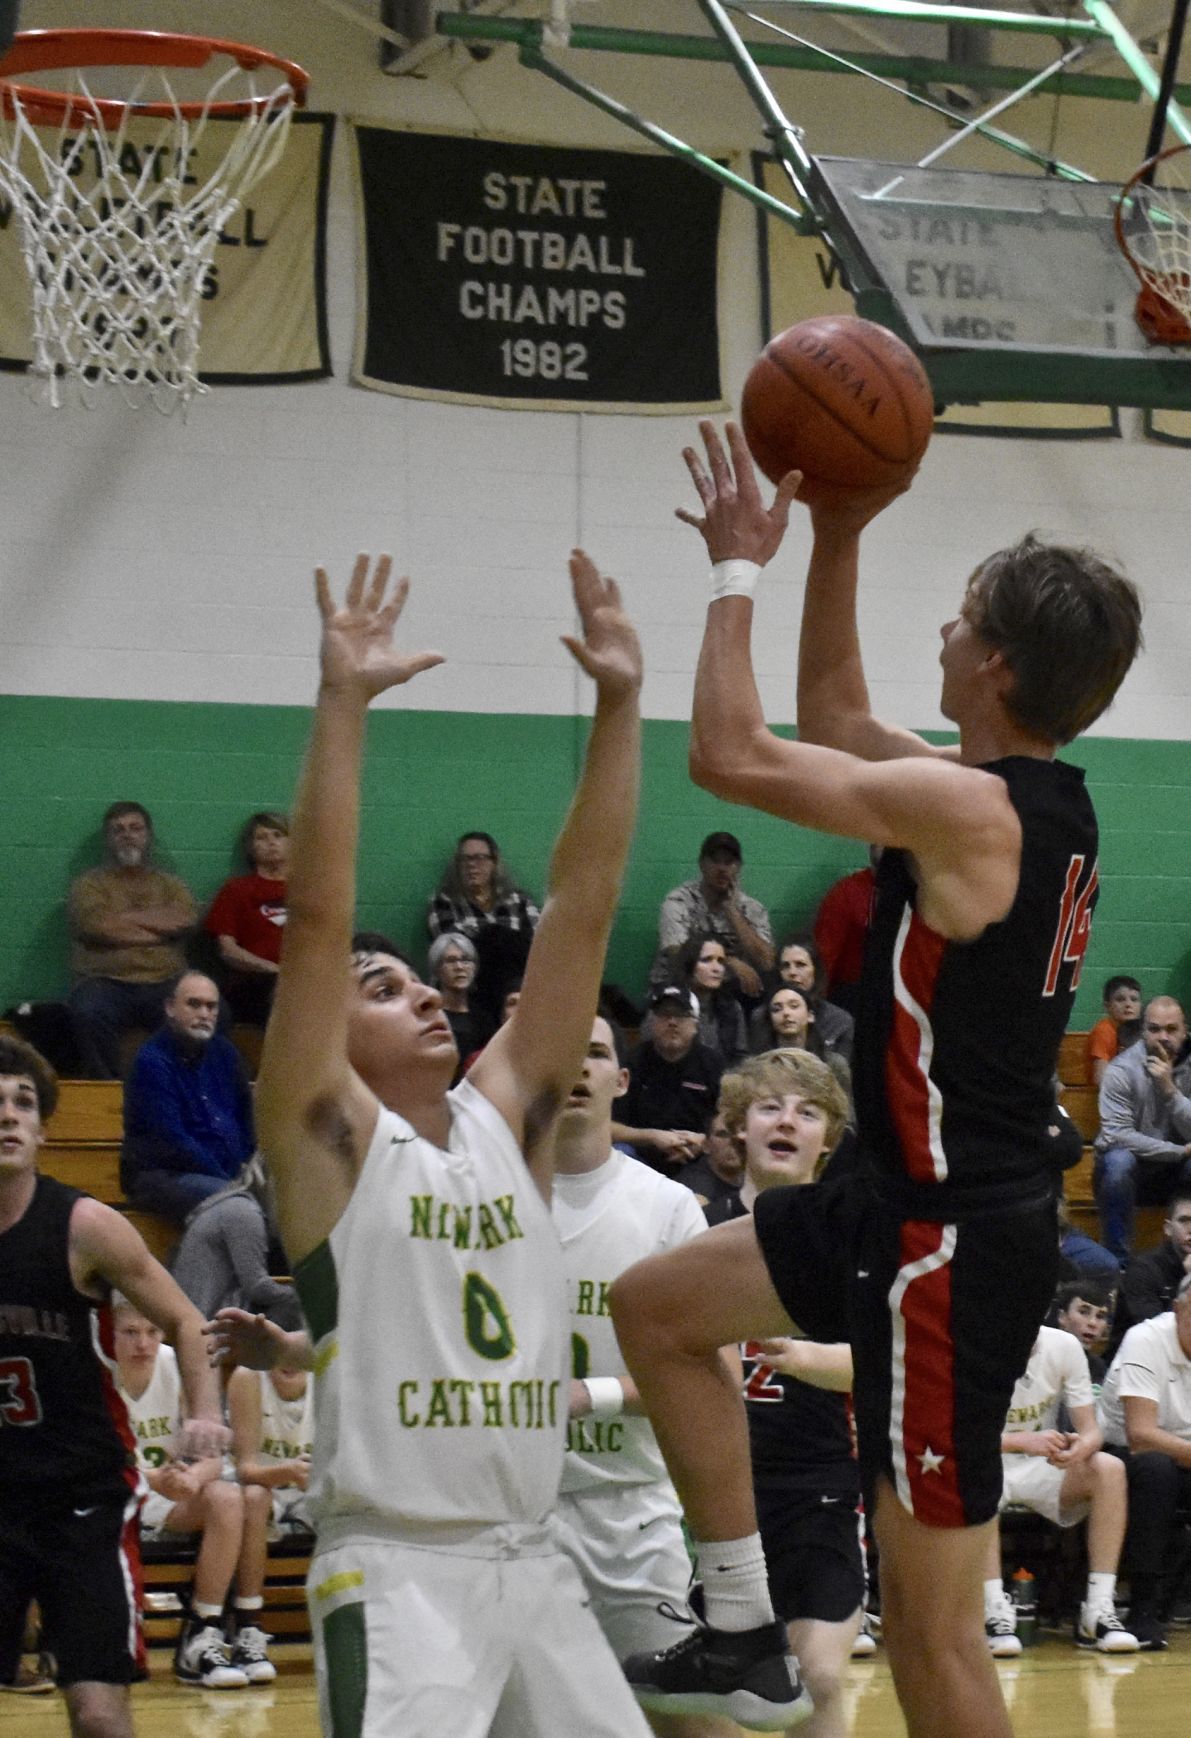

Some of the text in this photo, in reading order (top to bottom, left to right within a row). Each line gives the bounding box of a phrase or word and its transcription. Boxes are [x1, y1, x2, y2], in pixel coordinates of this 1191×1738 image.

[483, 172, 607, 219] STATE
[436, 222, 646, 278] FOOTBALL
[459, 280, 627, 330] CHAMPS
[501, 338, 589, 381] 1982
[1042, 854, 1098, 998] 14
[409, 1194, 525, 1250] NEWRK
[463, 1270, 517, 1361] 0
